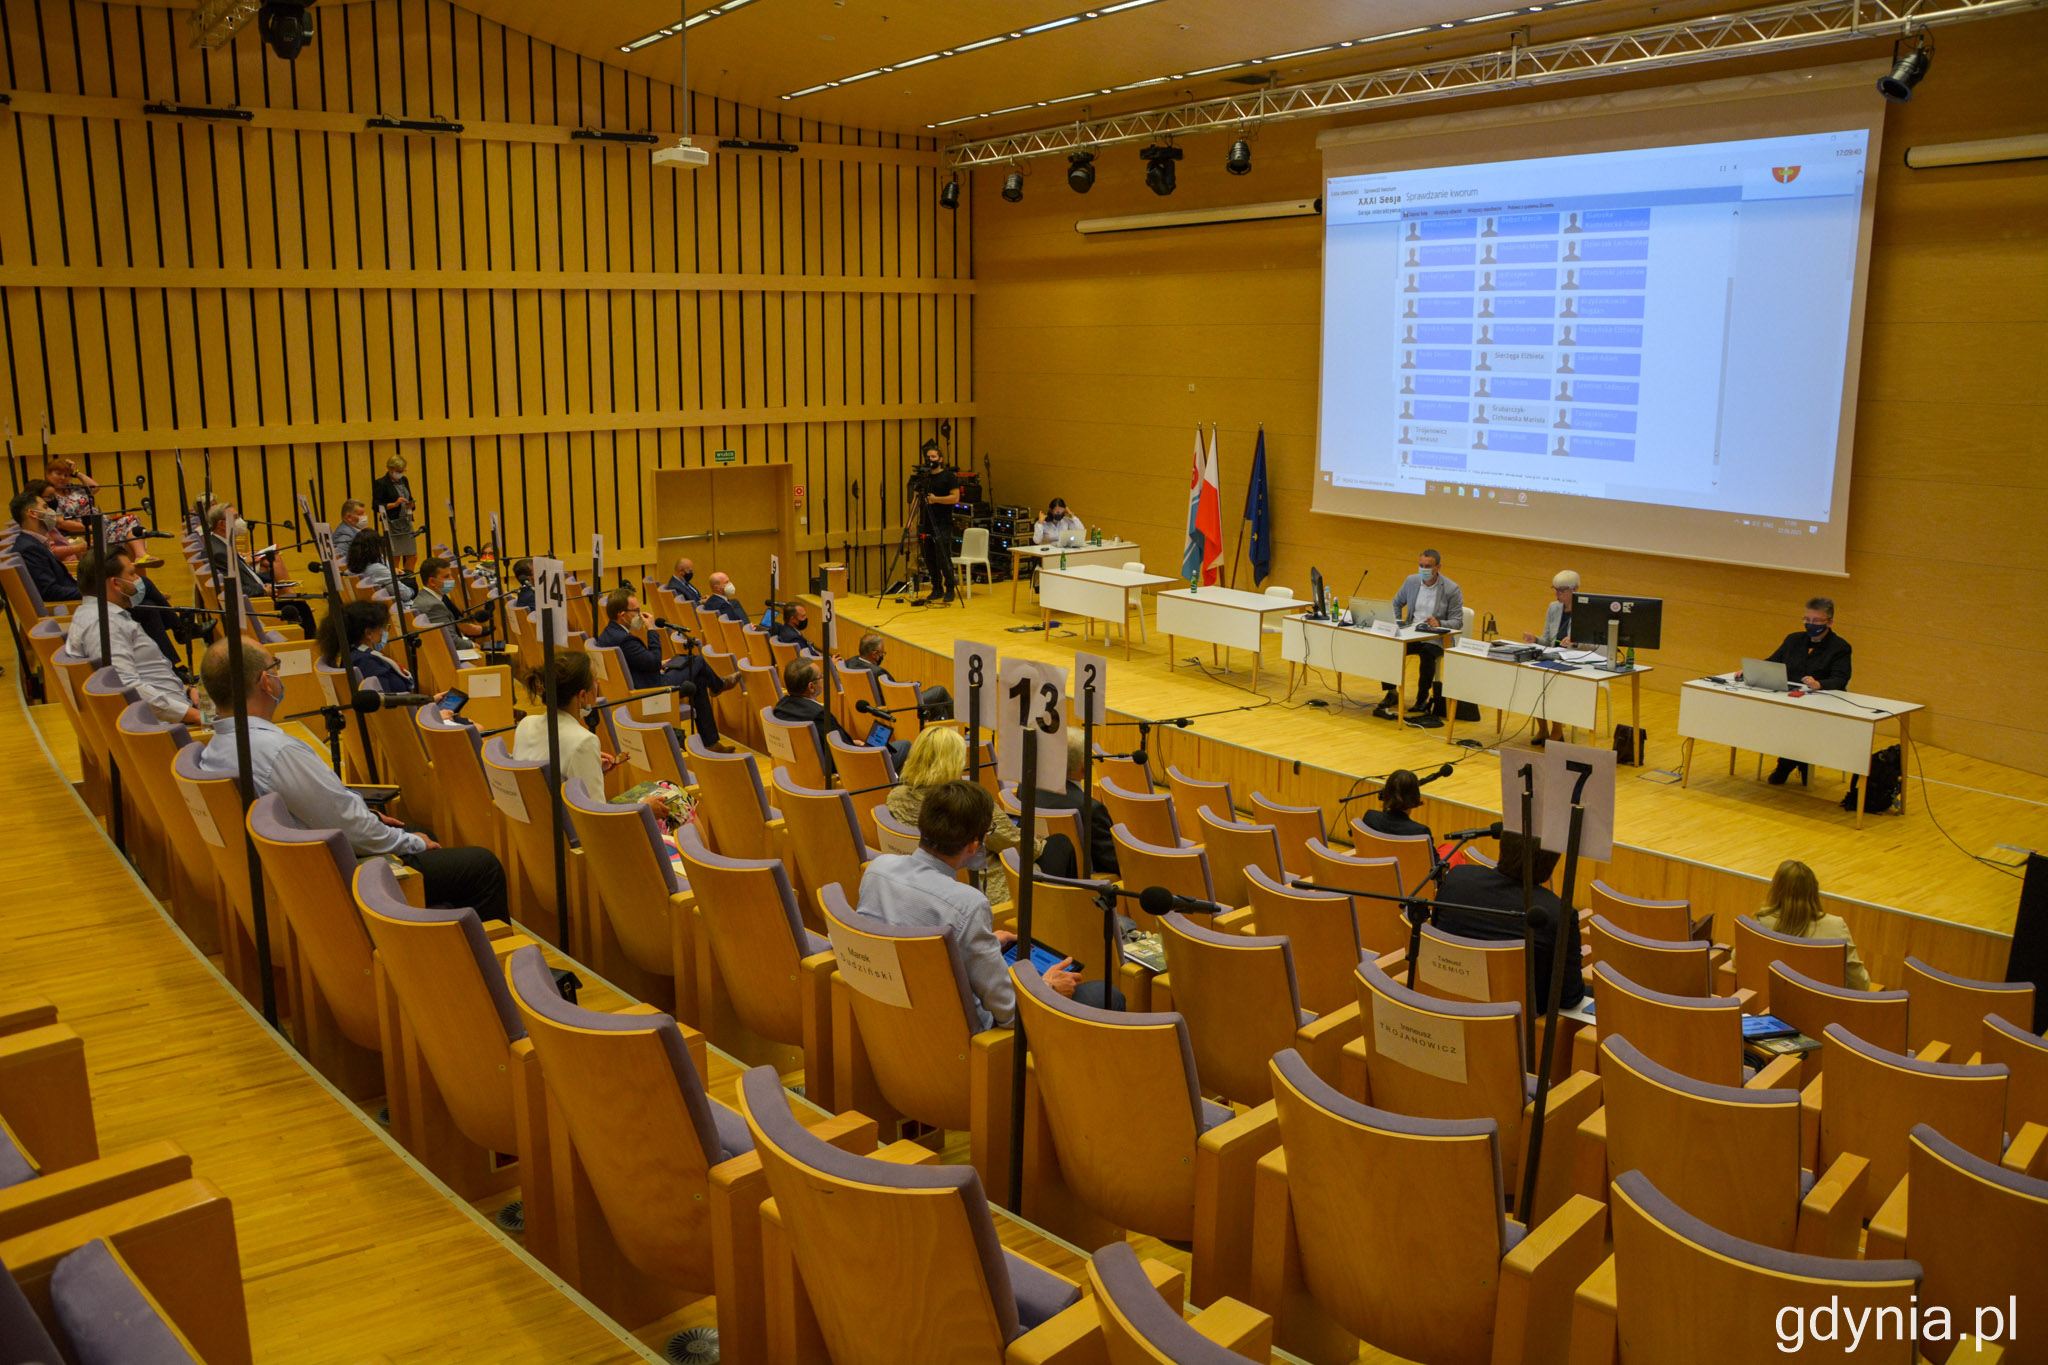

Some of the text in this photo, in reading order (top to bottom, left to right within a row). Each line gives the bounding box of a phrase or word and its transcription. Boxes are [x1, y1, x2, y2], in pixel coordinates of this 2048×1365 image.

[1358, 195, 1402, 206] XXXI Sesja
[1406, 188, 1479, 203] Sprawdzanie kworum
[595, 540, 600, 558] 4
[538, 570, 563, 608] 14
[826, 600, 832, 622] 3
[968, 654, 983, 688] 8
[1083, 664, 1096, 692] 2
[1009, 677, 1060, 734] 13
[1518, 763, 1533, 798] 1
[1566, 760, 1592, 805] 7
[848, 946, 871, 962] Marek
[1431, 960, 1471, 976] SZEMIOT
[1380, 1022, 1457, 1054] TROJANOWICZ
[1400, 1022, 1432, 1040] Ireneusz
